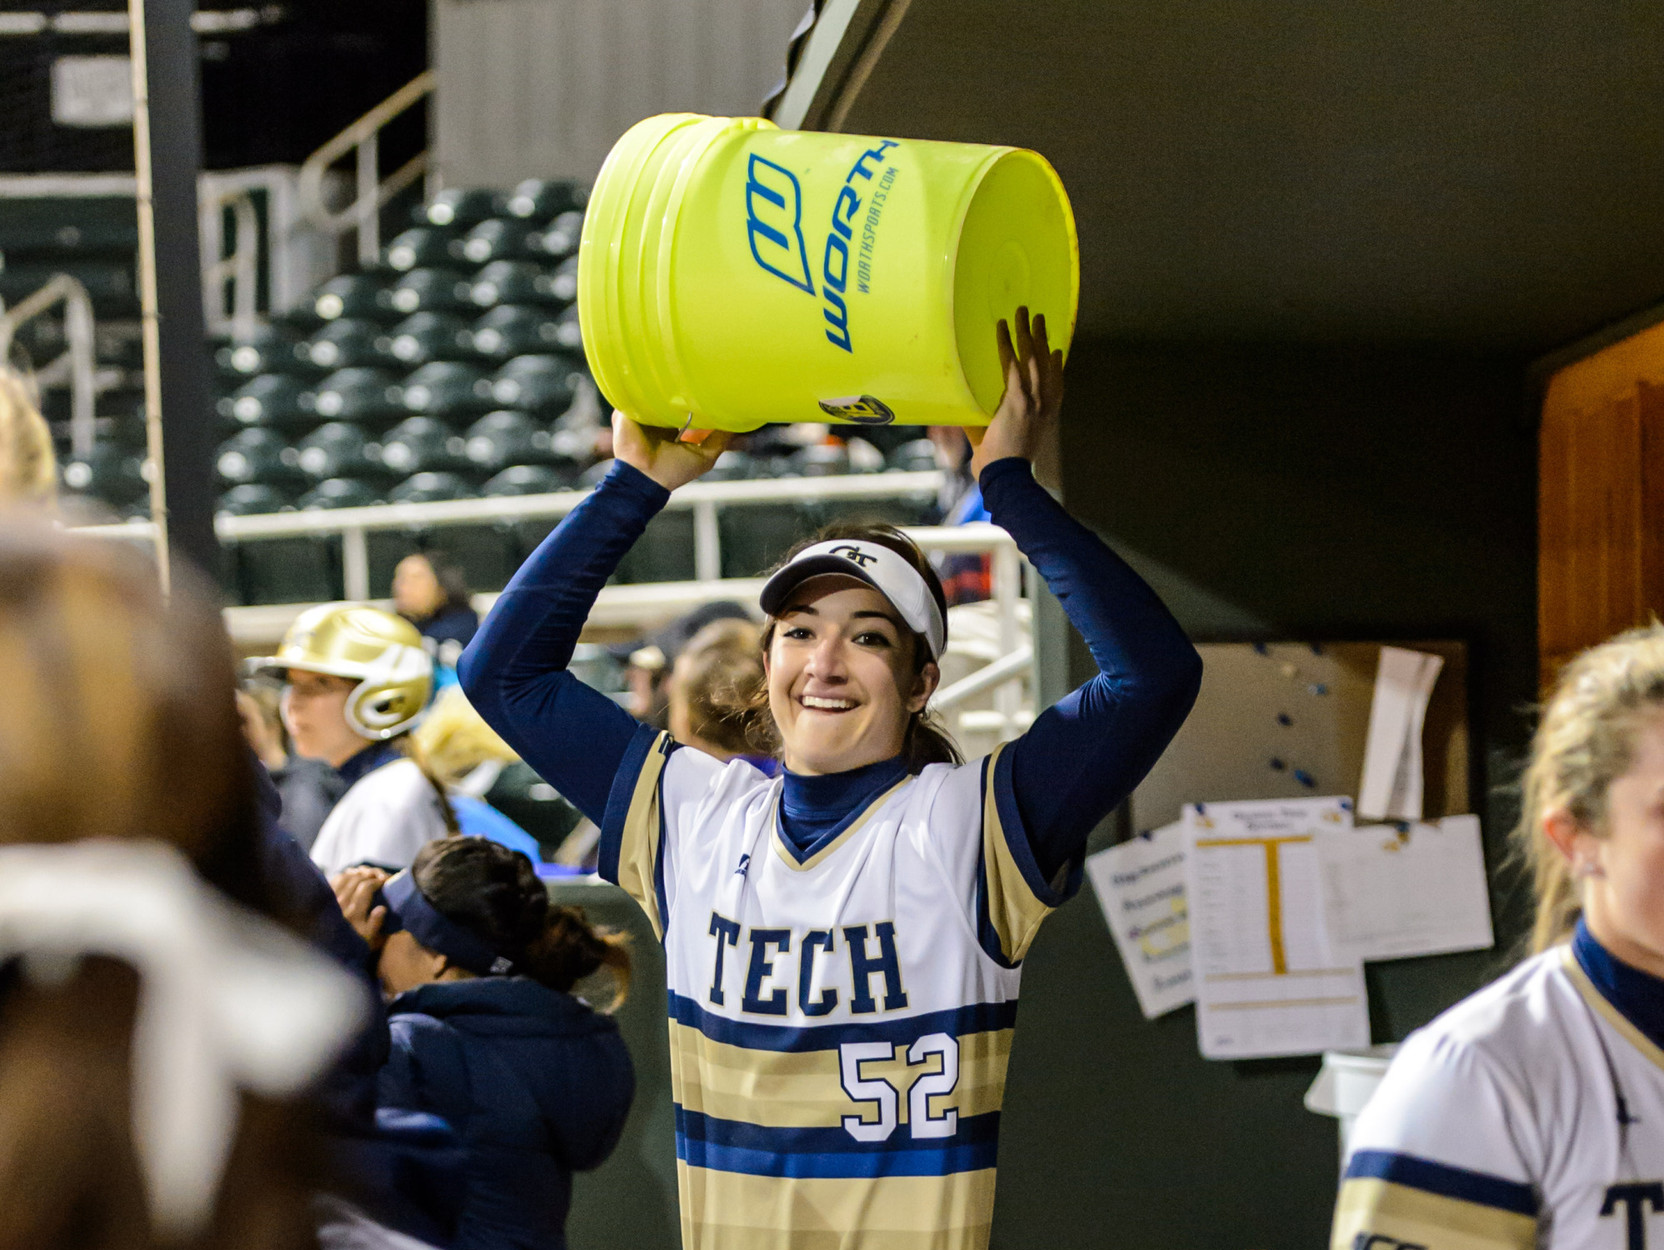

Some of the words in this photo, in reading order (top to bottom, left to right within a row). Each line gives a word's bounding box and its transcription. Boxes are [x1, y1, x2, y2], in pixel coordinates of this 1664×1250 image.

[822, 139, 900, 354] WORTH
[857, 166, 899, 294] WORTHSPORTS.COM
[708, 908, 909, 1018] TECH
[837, 1032, 961, 1143] 52
